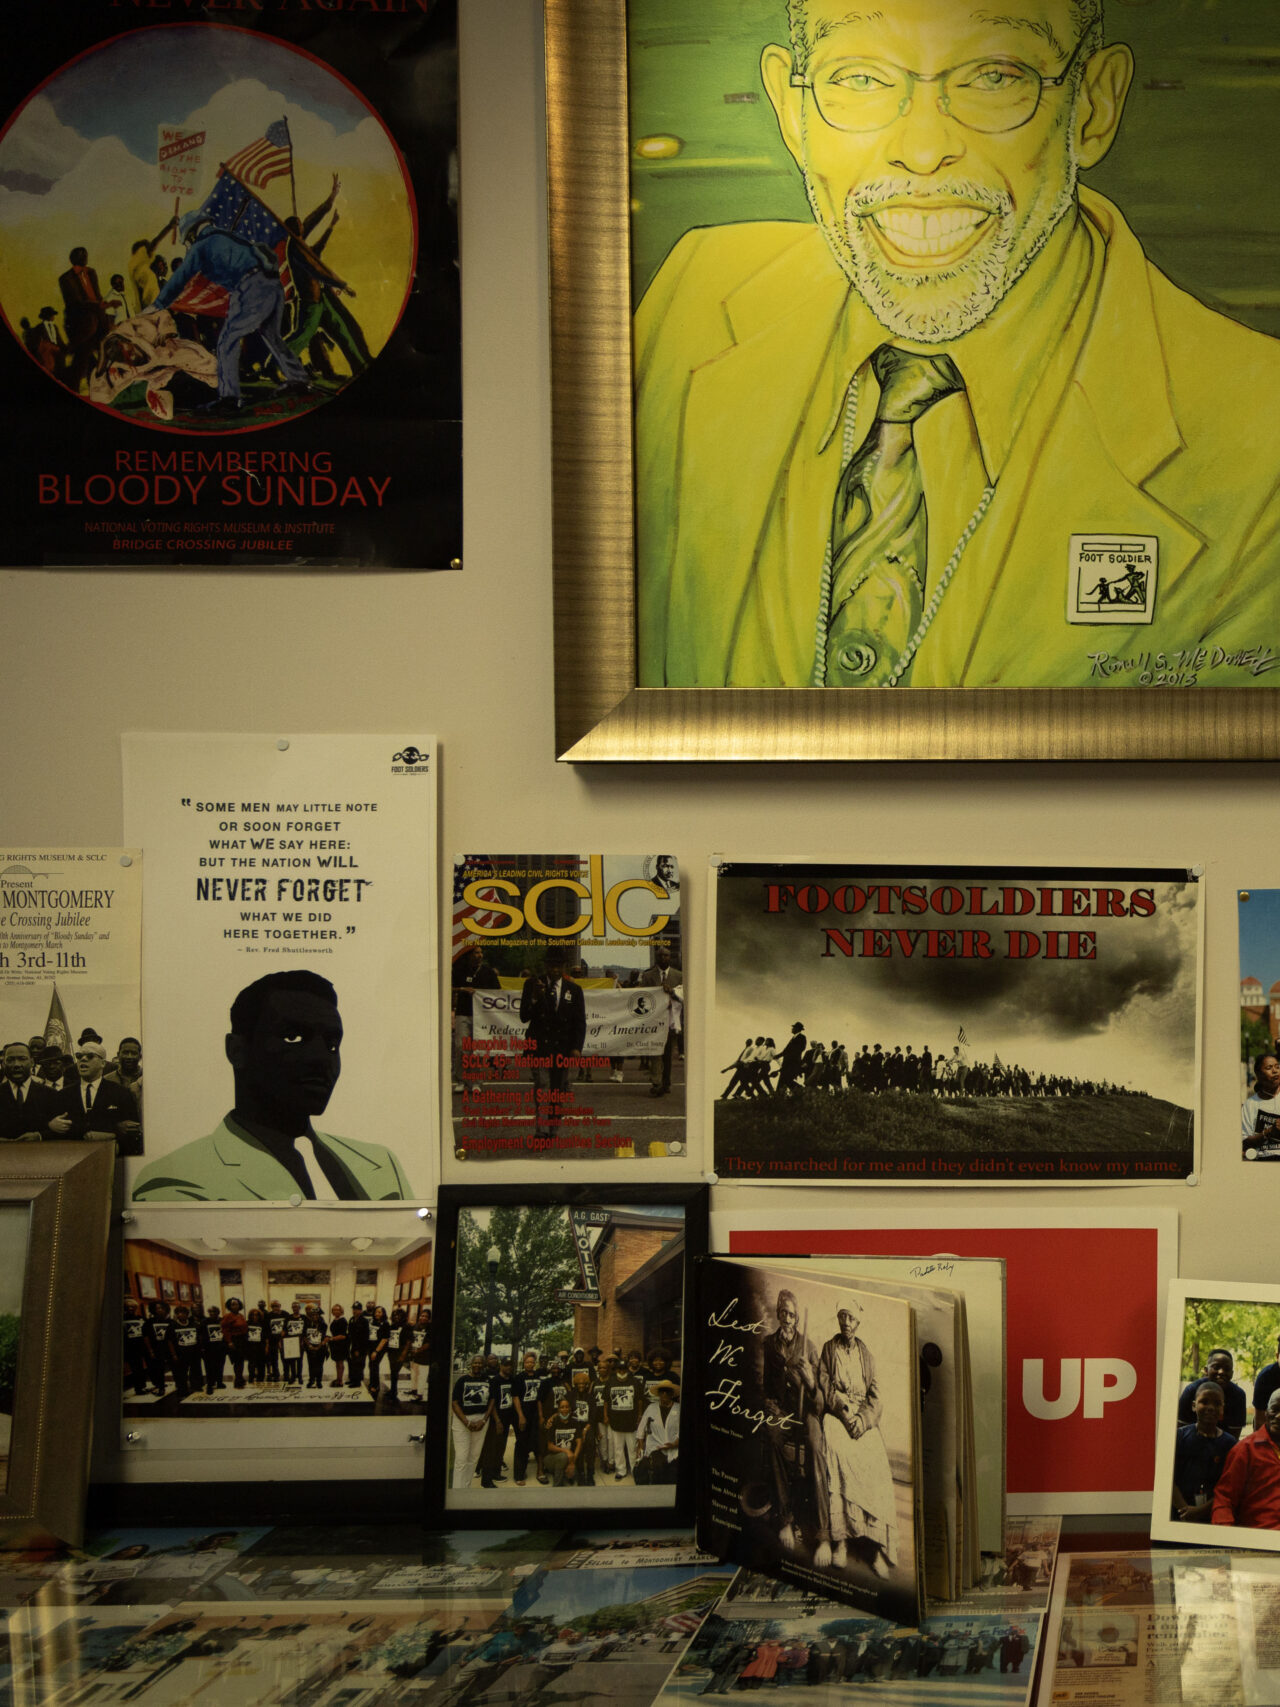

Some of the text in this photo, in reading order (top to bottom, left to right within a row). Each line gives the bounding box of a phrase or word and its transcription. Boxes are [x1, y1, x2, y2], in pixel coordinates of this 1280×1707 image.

[114, 449, 333, 473] REMEMBERING
[38, 473, 392, 507] BLOODY SUNDAY
[84, 521, 336, 535] NATIONAL VOTING RIGHTS MUSEUM & INSTITUTE
[112, 539, 294, 551] BRIDGE CROSSING JUBILEE
[1079, 553, 1152, 563] FOOT SOLDIER
[391, 765, 429, 773] FOOT SOLDIERS
[241, 802, 270, 812] MEN
[276, 803, 299, 812] MAY
[303, 803, 341, 812] LITTLE
[345, 803, 378, 812] NOTE
[219, 821, 341, 832] OR SOON FORGET
[209, 838, 351, 850] WHAT WE SAY HERE:
[199, 855, 359, 868] BUT THE NATION WILL
[498, 869, 526, 878] LEADING
[527, 870, 543, 878] CIVIL
[545, 870, 568, 878] RIGHTS
[0, 880, 33, 888] Present
[196, 877, 374, 902] NEVER FORGET
[3, 890, 115, 909] MONTGOMERY
[462, 855, 671, 937] sclc
[763, 883, 1156, 918] FOOTSOLDIERS
[10, 911, 91, 930] Crossing Jubilee
[240, 912, 332, 922] WHAT WE DID
[223, 929, 259, 939] HERE
[474, 938, 499, 946] National
[501, 938, 528, 947] Magazine
[537, 938, 547, 946] the
[548, 938, 576, 946] Southern
[282, 946, 333, 954] Shuttlesworth
[821, 928, 1096, 960] NEVER DIE
[17, 951, 86, 968] 3rd-11th
[462, 1036, 537, 1051] Memphis Hosts
[462, 1053, 611, 1069] SCLC National Convention
[462, 1088, 575, 1106] A Gathering of Soldiers
[462, 1133, 633, 1152] Employment Opportunities Section
[724, 1157, 1183, 1177] They marched for me and they didn't even know my name.
[574, 1223, 598, 1290] MOTEL
[708, 1297, 771, 1335] Lest
[709, 1339, 744, 1367] We
[1021, 1357, 1138, 1421] UP
[705, 1378, 804, 1434] Forget
